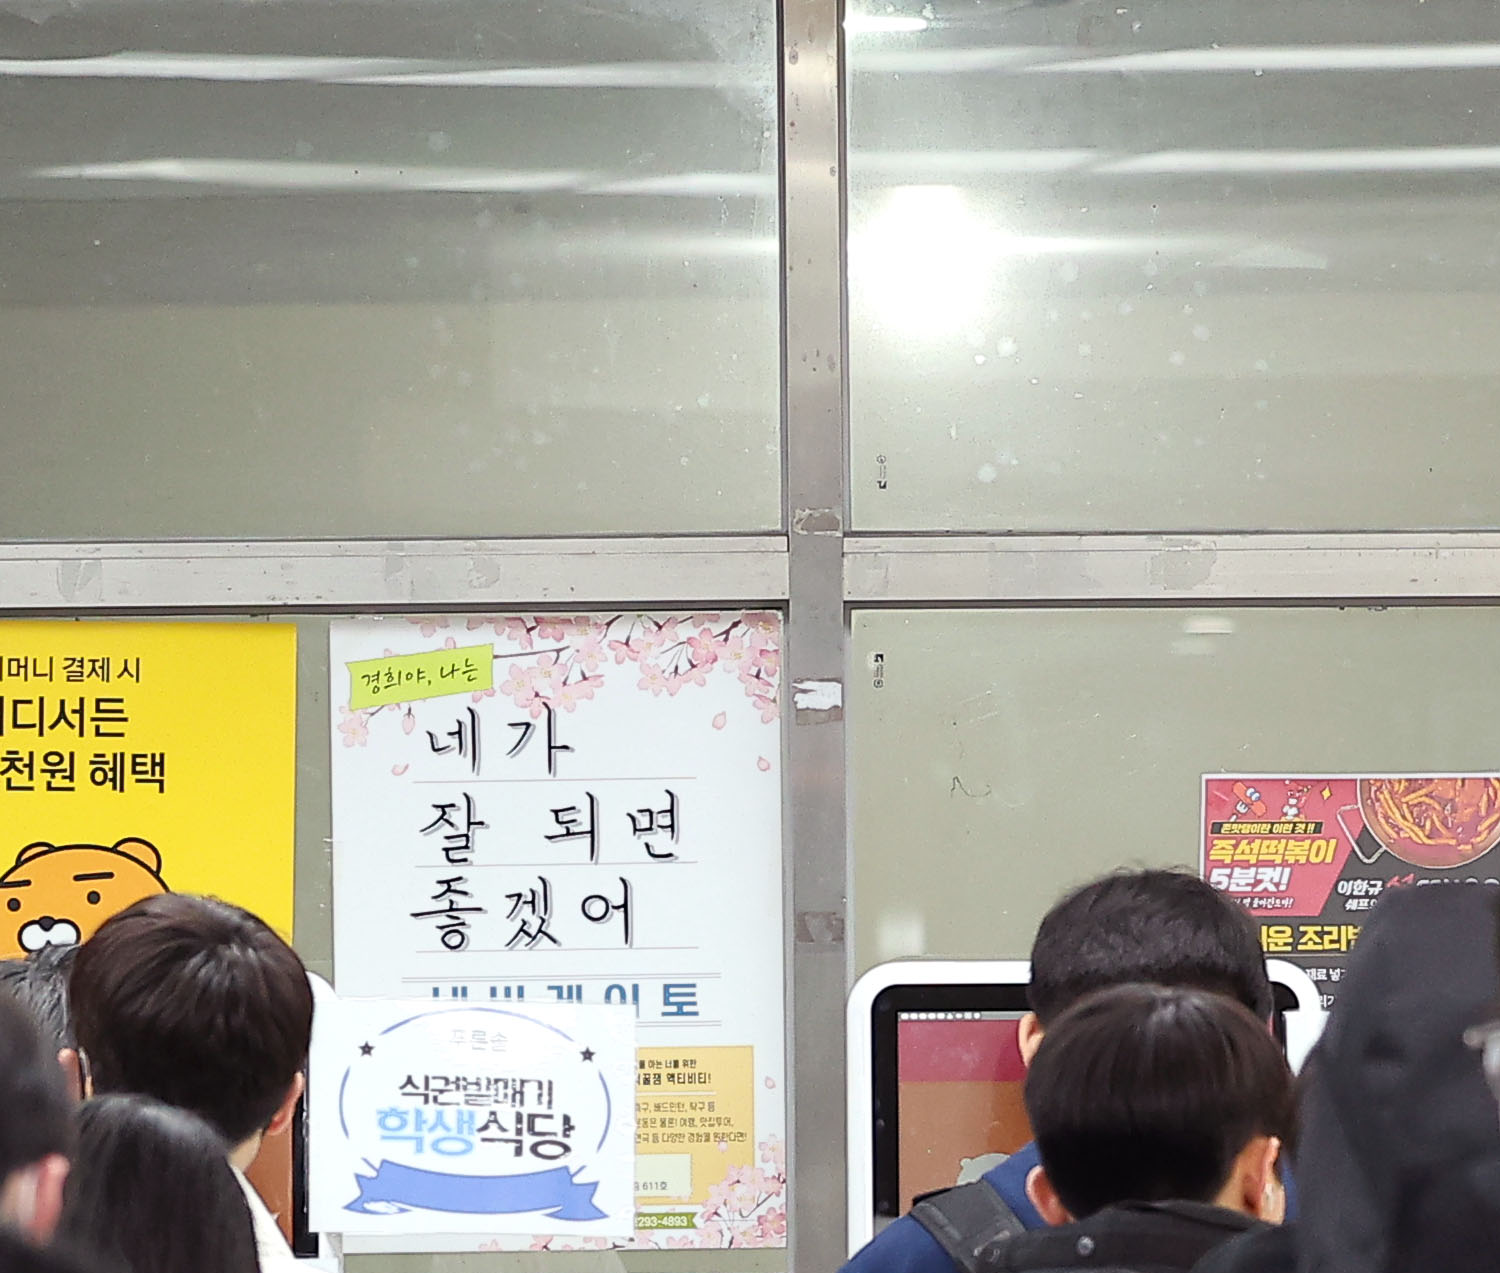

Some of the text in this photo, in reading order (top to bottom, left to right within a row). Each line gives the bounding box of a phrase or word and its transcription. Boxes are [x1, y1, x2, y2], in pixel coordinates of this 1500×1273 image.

[63, 657, 110, 683] 결제
[117, 657, 140, 683] 시
[360, 661, 480, 696] 경희야, 나는
[426, 702, 573, 775] 네가
[89, 752, 164, 793] 혜택
[420, 789, 675, 864] 잘 되면
[1208, 838, 1338, 865] 즉석떡볶이
[1209, 867, 1291, 892] 5분컷!
[1337, 878, 1384, 896] 이한규
[410, 876, 629, 950] 좋겠어
[379, 1106, 575, 1160] 학생식당
